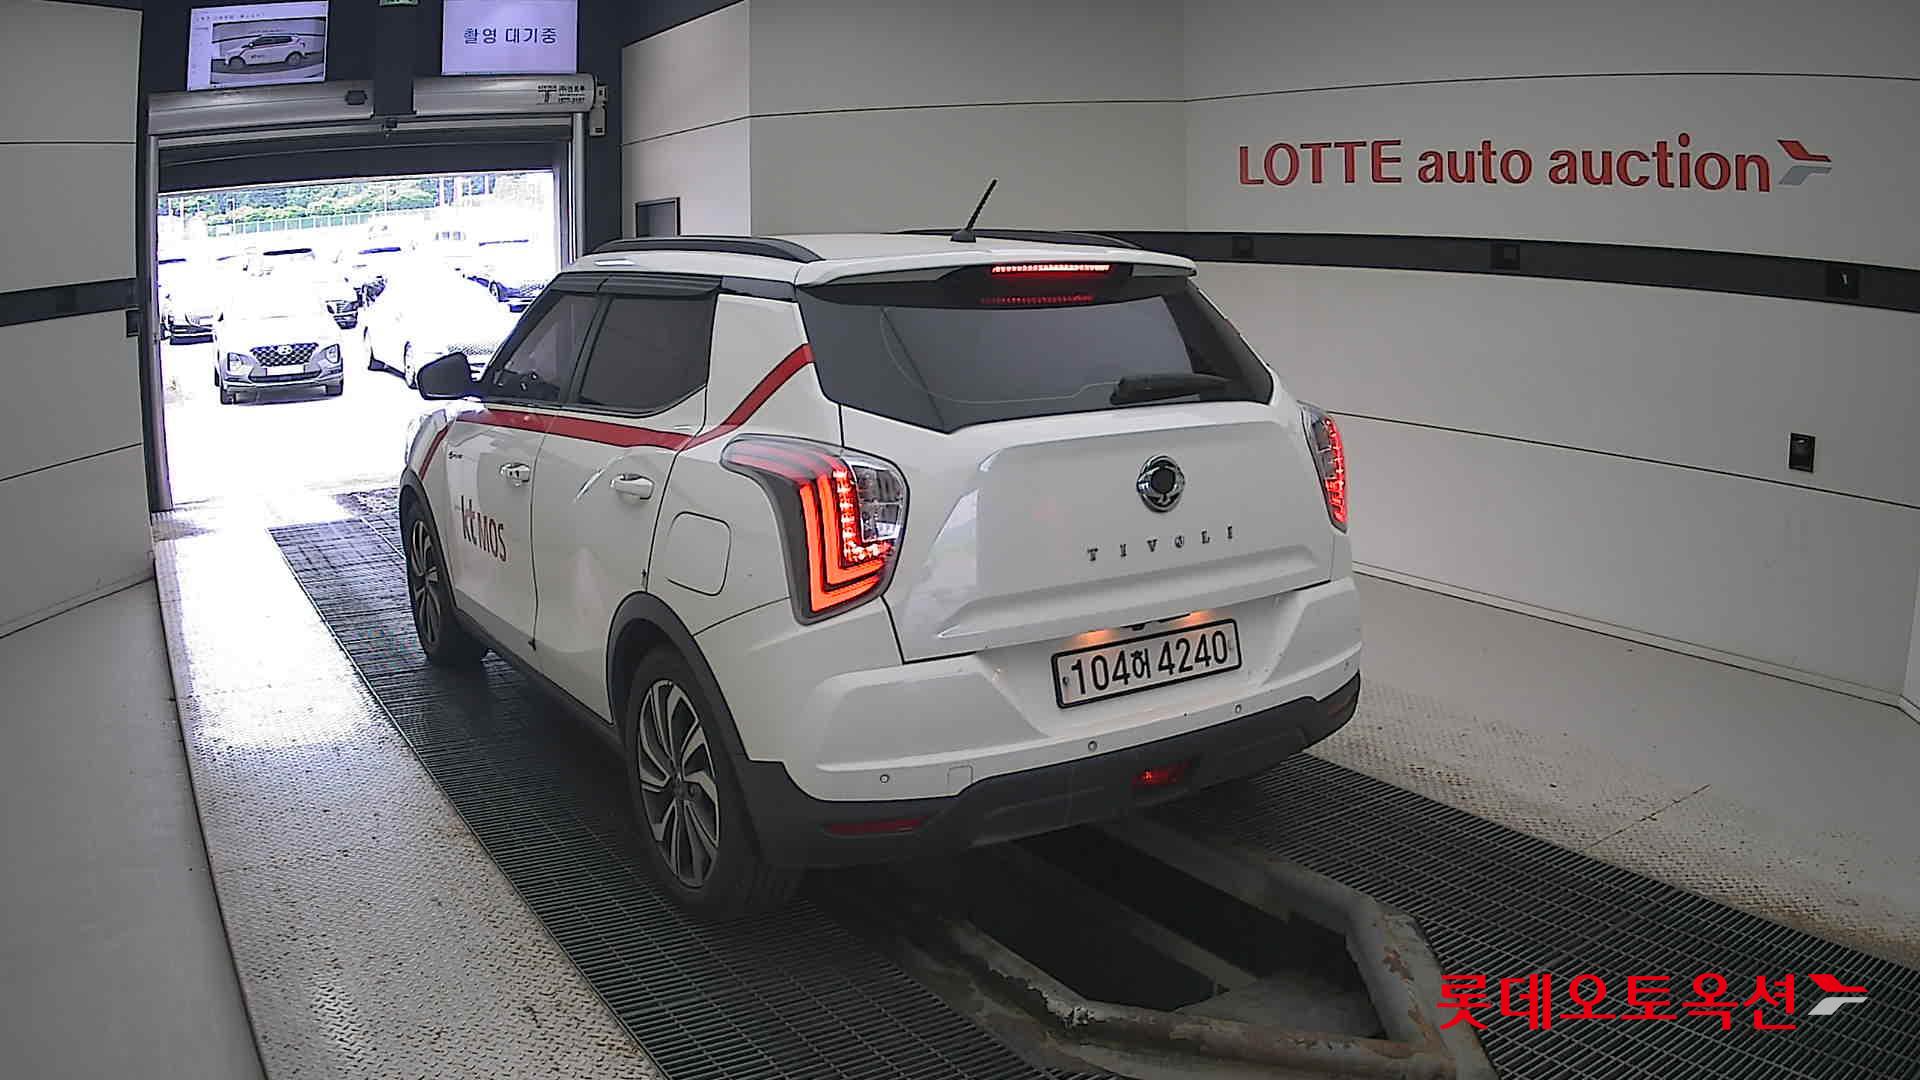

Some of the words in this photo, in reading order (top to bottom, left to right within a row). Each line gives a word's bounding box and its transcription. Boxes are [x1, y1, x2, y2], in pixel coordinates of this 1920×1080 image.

[463, 27, 497, 44] 촬영
[505, 27, 558, 44] 대기중
[1238, 140, 1402, 186] LOTTE
[1417, 140, 1533, 185] auto
[1548, 132, 1772, 193] auction
[1087, 525, 1234, 561] TIVOLI
[1158, 630, 1229, 676] 4240
